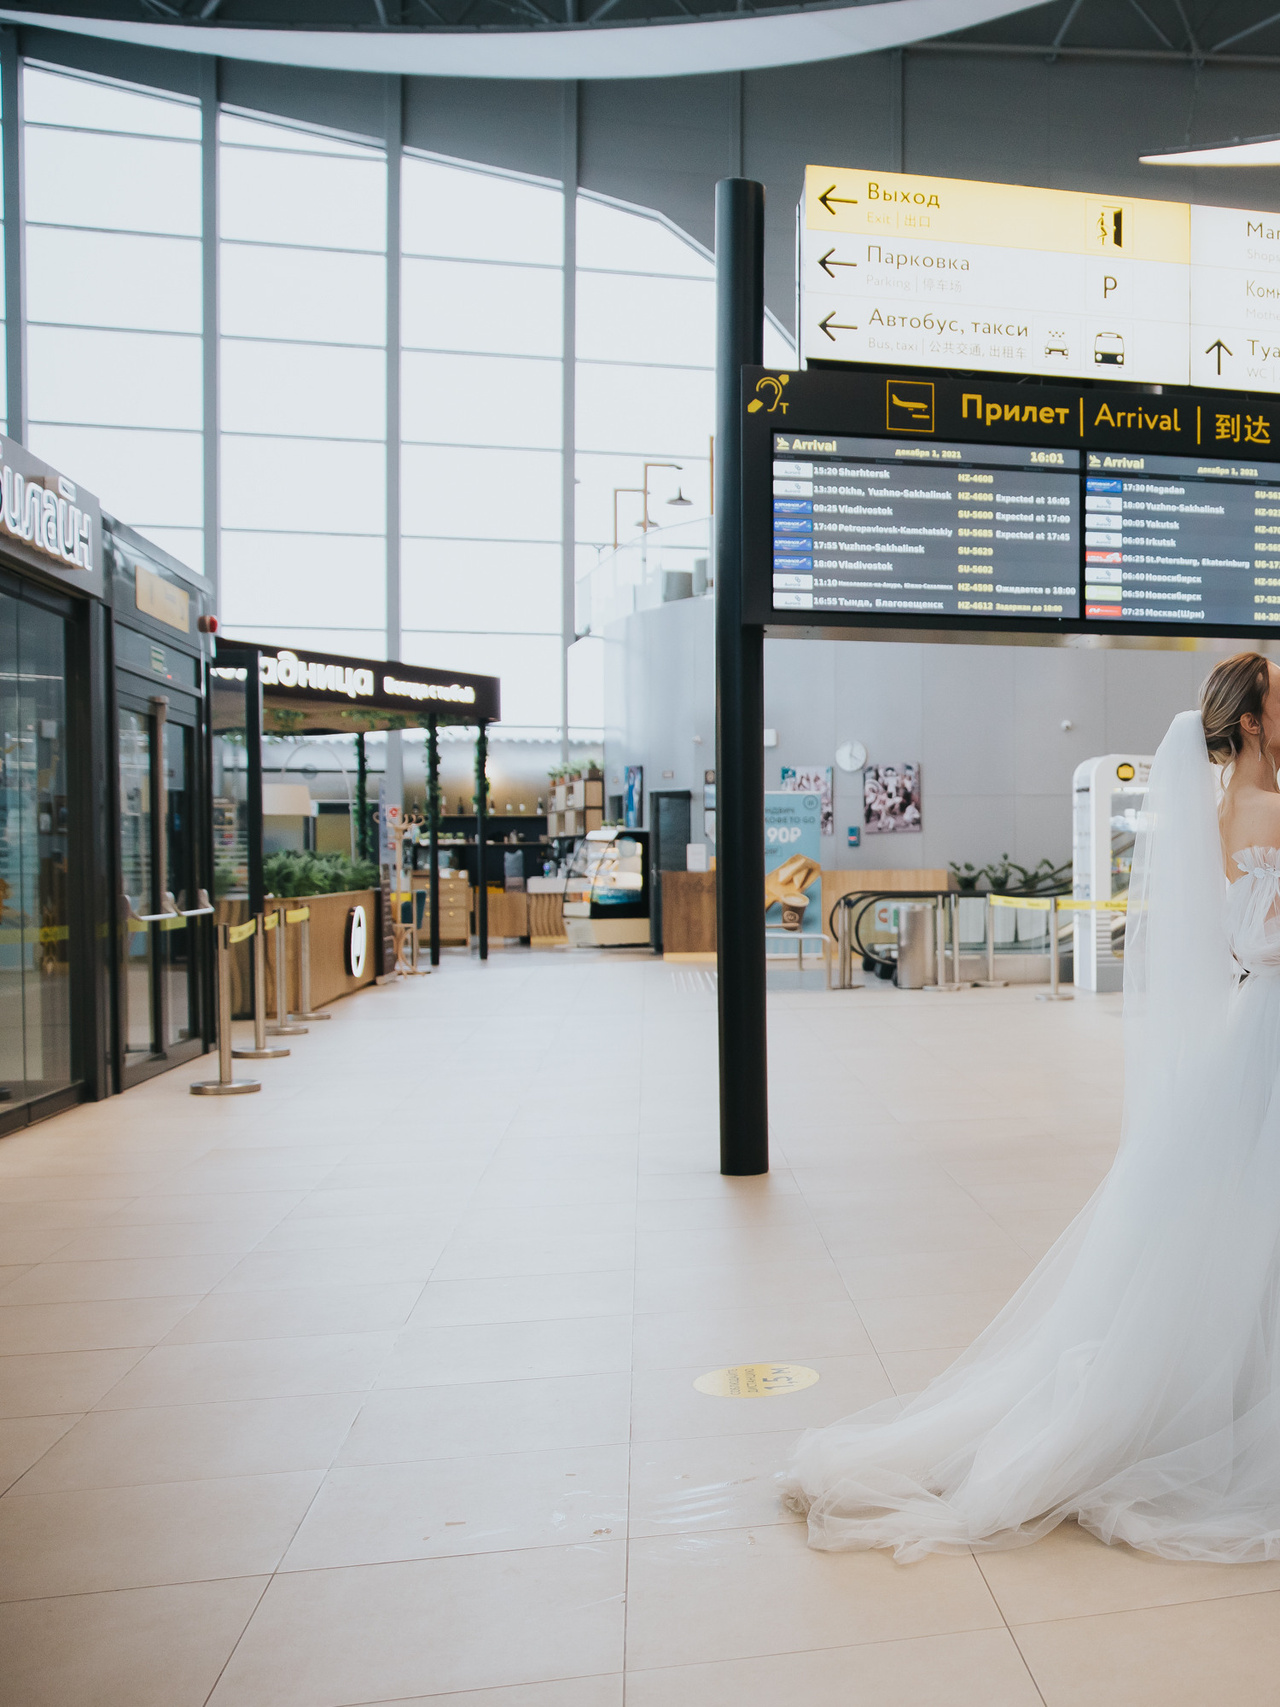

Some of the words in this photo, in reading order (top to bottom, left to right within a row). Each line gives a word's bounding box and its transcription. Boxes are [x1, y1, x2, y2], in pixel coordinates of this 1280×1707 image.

[868, 182, 940, 208] Выход
[867, 212, 890, 224] Exit
[904, 214, 931, 228] 出口
[868, 245, 970, 271] Парковка
[866, 274, 910, 291] Parking
[868, 308, 965, 336] Автобус,
[970, 320, 1028, 337] такси
[962, 393, 1070, 426] Прилет
[1094, 402, 1182, 432] Arrival
[1215, 413, 1271, 444] 到达
[792, 439, 837, 452] Arrival
[1030, 452, 1064, 464] 16:01
[813, 466, 838, 476] 15:20
[1103, 456, 1144, 470] Arrival
[838, 486, 866, 497] Okha,
[868, 487, 952, 500] Yuzhno-Sakhalinsk
[996, 494, 1034, 504] Expected
[1036, 496, 1045, 504] at
[1146, 484, 1186, 496] Magadan
[0, 440, 93, 571] илайн
[838, 504, 894, 516] Vladivostok
[996, 512, 1034, 522] Expected
[1036, 514, 1045, 522] at
[1146, 502, 1225, 515] Yuzhno-Sakhalinsk
[813, 522, 838, 532] 17:40
[996, 530, 1034, 540] Expected
[1036, 532, 1045, 540] at
[1146, 520, 1180, 530] Yakutsk
[838, 542, 925, 554] Yuzhno-Sakhalinsk
[1146, 537, 1176, 548] Irkutsk
[838, 560, 894, 572] Vladivostok
[838, 598, 872, 608] Тында,
[876, 598, 944, 610] Благовещенск
